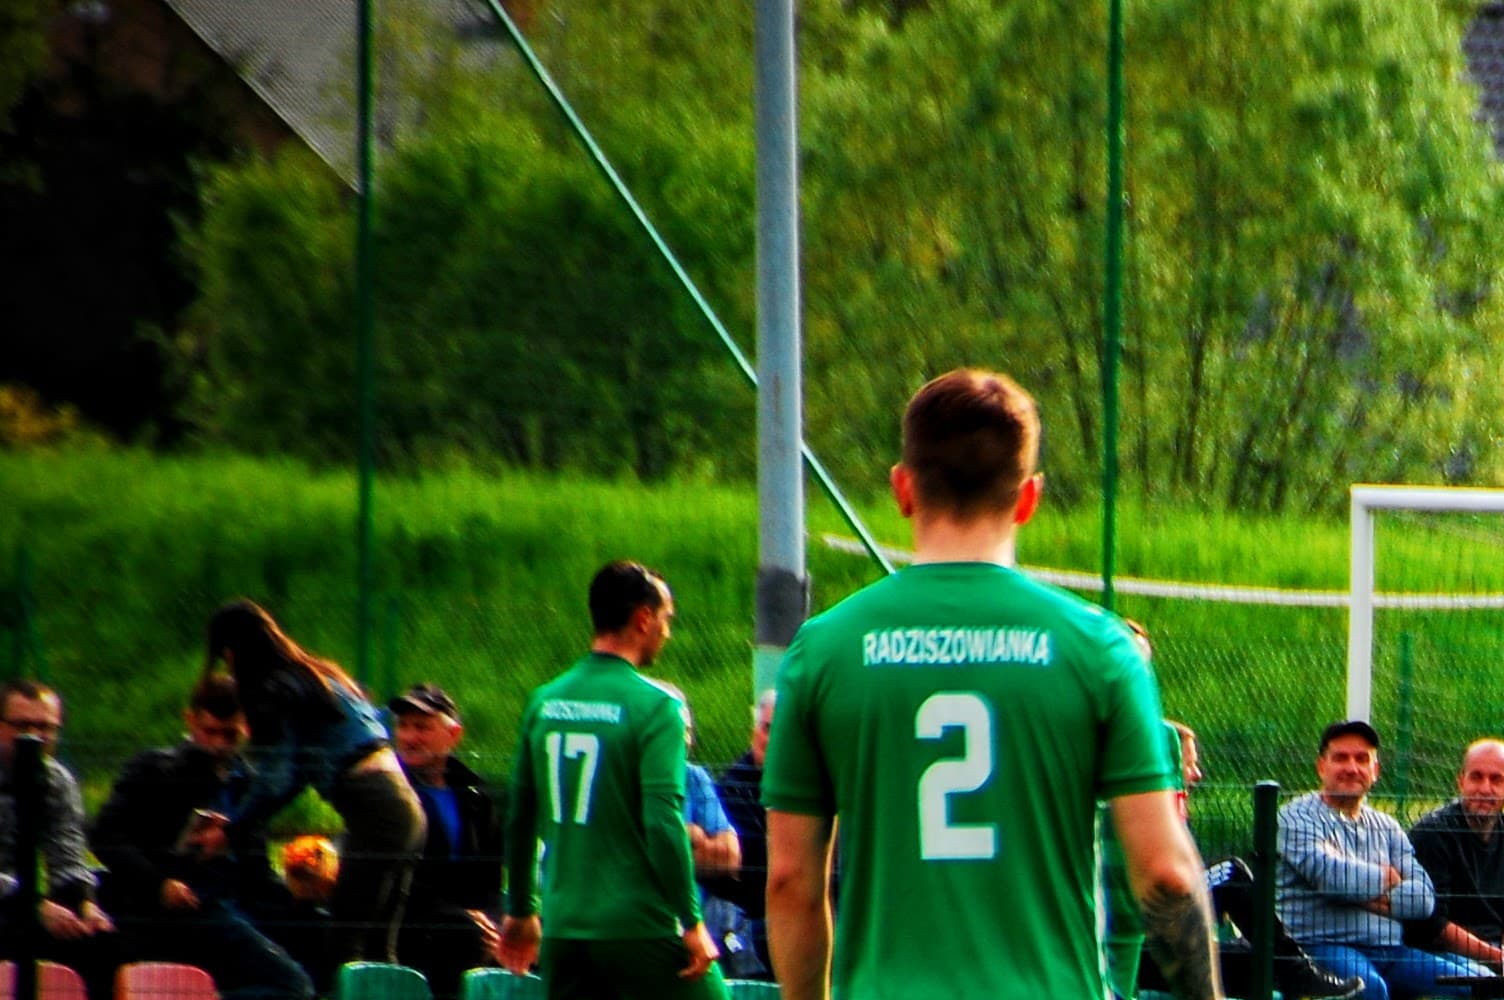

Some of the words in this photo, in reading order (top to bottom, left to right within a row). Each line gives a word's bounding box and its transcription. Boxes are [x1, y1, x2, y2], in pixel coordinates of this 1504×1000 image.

[863, 629, 1051, 666] RADZISZOWIANKA
[545, 731, 600, 824] 17
[914, 692, 995, 860] 2
